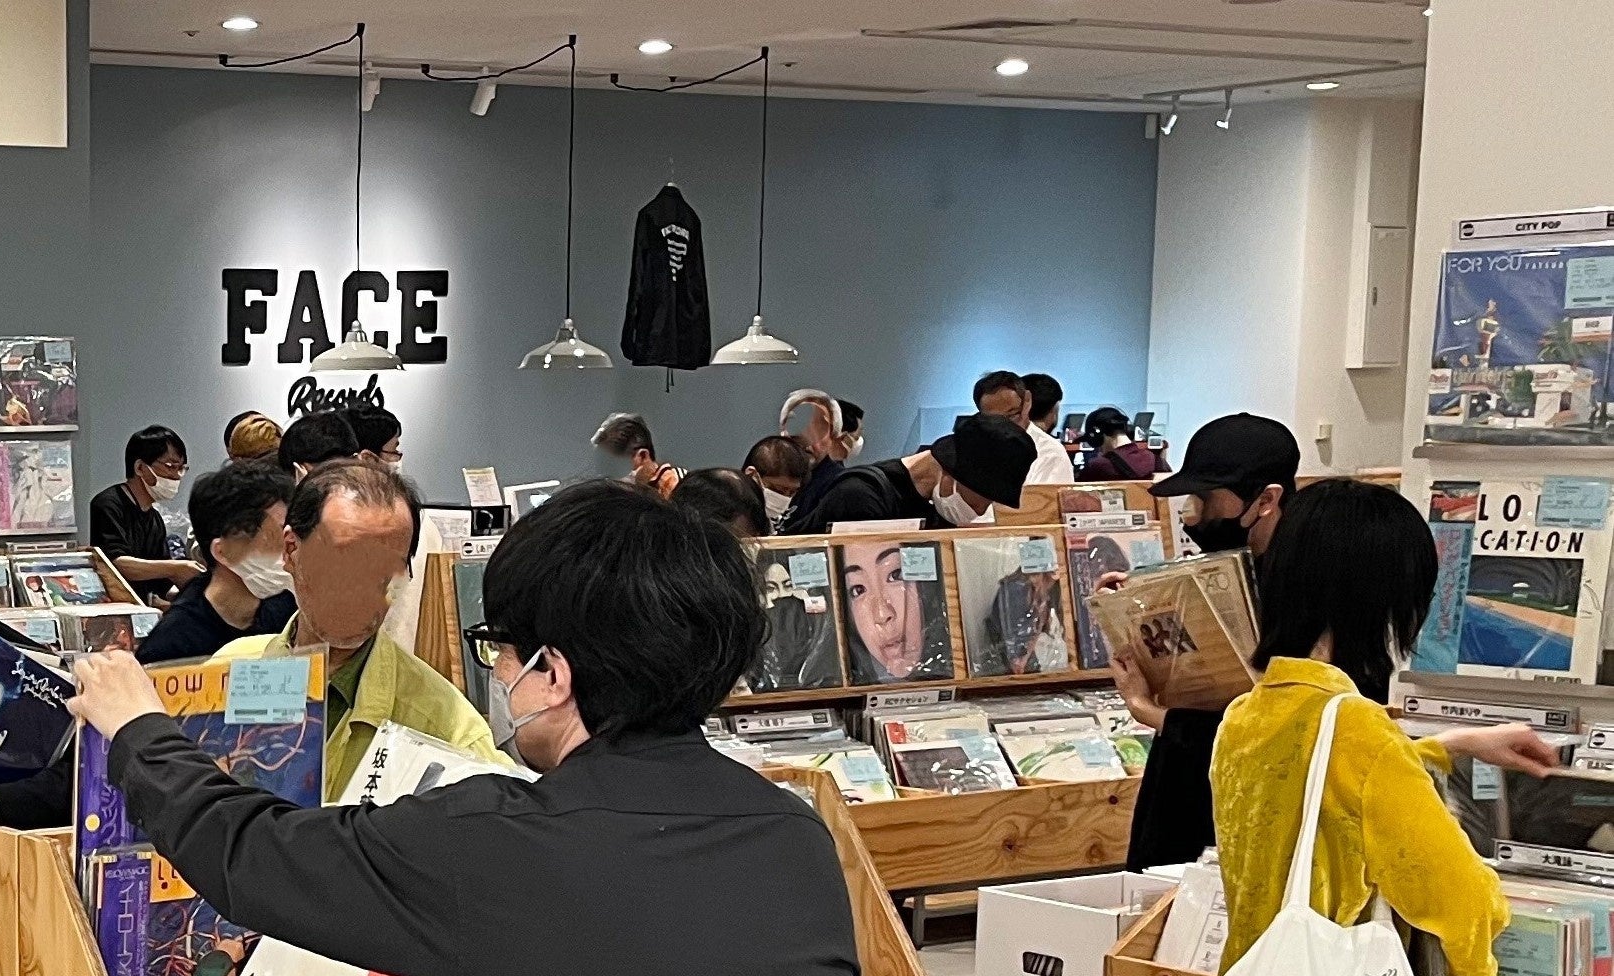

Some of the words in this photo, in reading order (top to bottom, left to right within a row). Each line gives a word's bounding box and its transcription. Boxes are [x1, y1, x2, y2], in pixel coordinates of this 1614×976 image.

[1515, 221, 1538, 231] CITY
[1541, 220, 1562, 230] POP
[1447, 256, 1483, 273] FOR
[1487, 255, 1523, 272] YOU
[222, 269, 448, 366] FACE
[288, 373, 385, 419] Records
